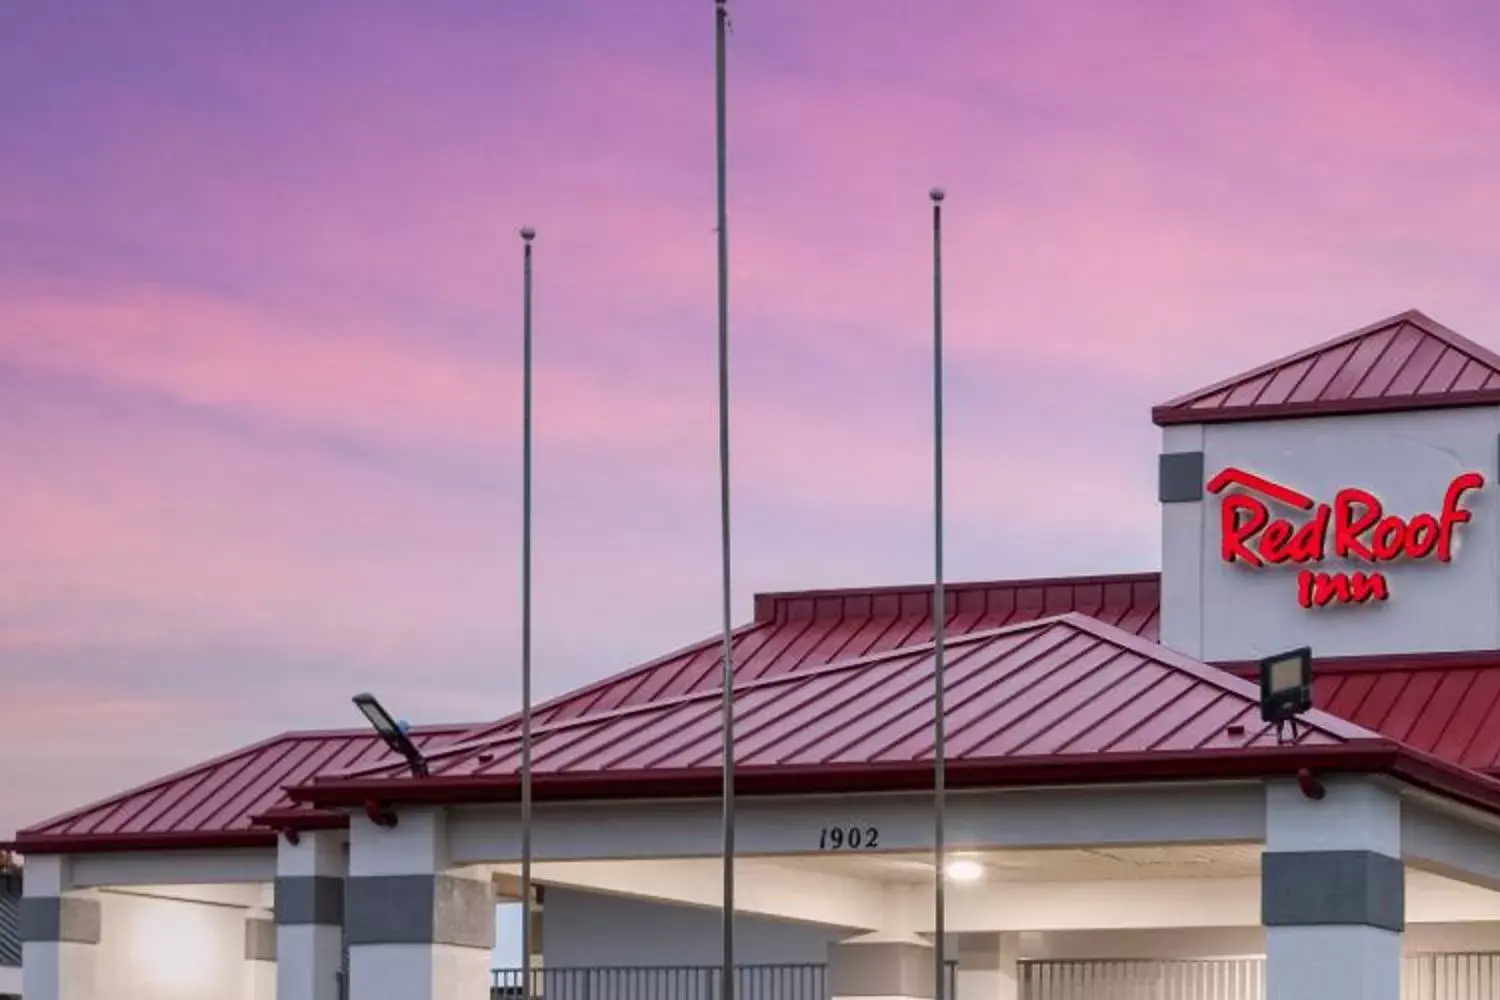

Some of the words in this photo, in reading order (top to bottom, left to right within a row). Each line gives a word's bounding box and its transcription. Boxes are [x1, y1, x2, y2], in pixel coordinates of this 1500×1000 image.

[1220, 494, 1331, 567] Red
[1334, 472, 1485, 562] Roof
[820, 827, 879, 849] 1902
